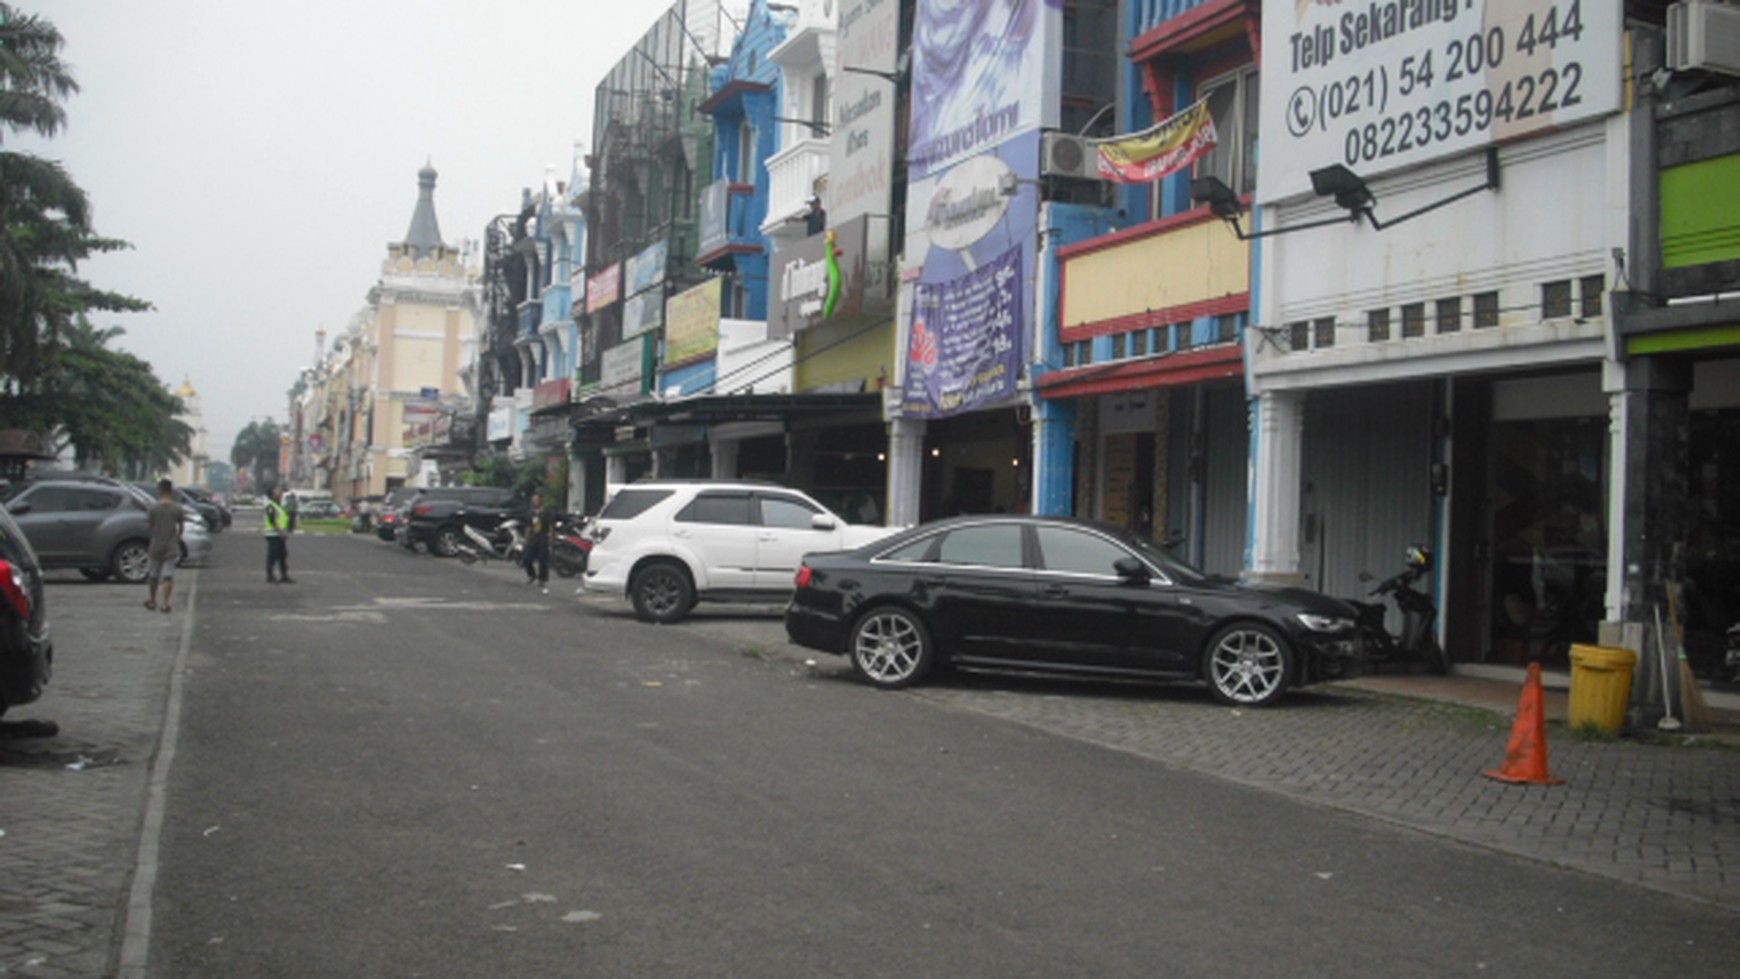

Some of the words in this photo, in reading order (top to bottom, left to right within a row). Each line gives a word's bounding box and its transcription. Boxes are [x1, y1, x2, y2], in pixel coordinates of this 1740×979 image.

[1289, 24, 1335, 73] Telp
[1319, 65, 1388, 131] (021)
[1399, 49, 1434, 96] 54
[1446, 26, 1505, 82] 200
[1516, 0, 1584, 56] 444
[1345, 61, 1583, 166] 082233594222
